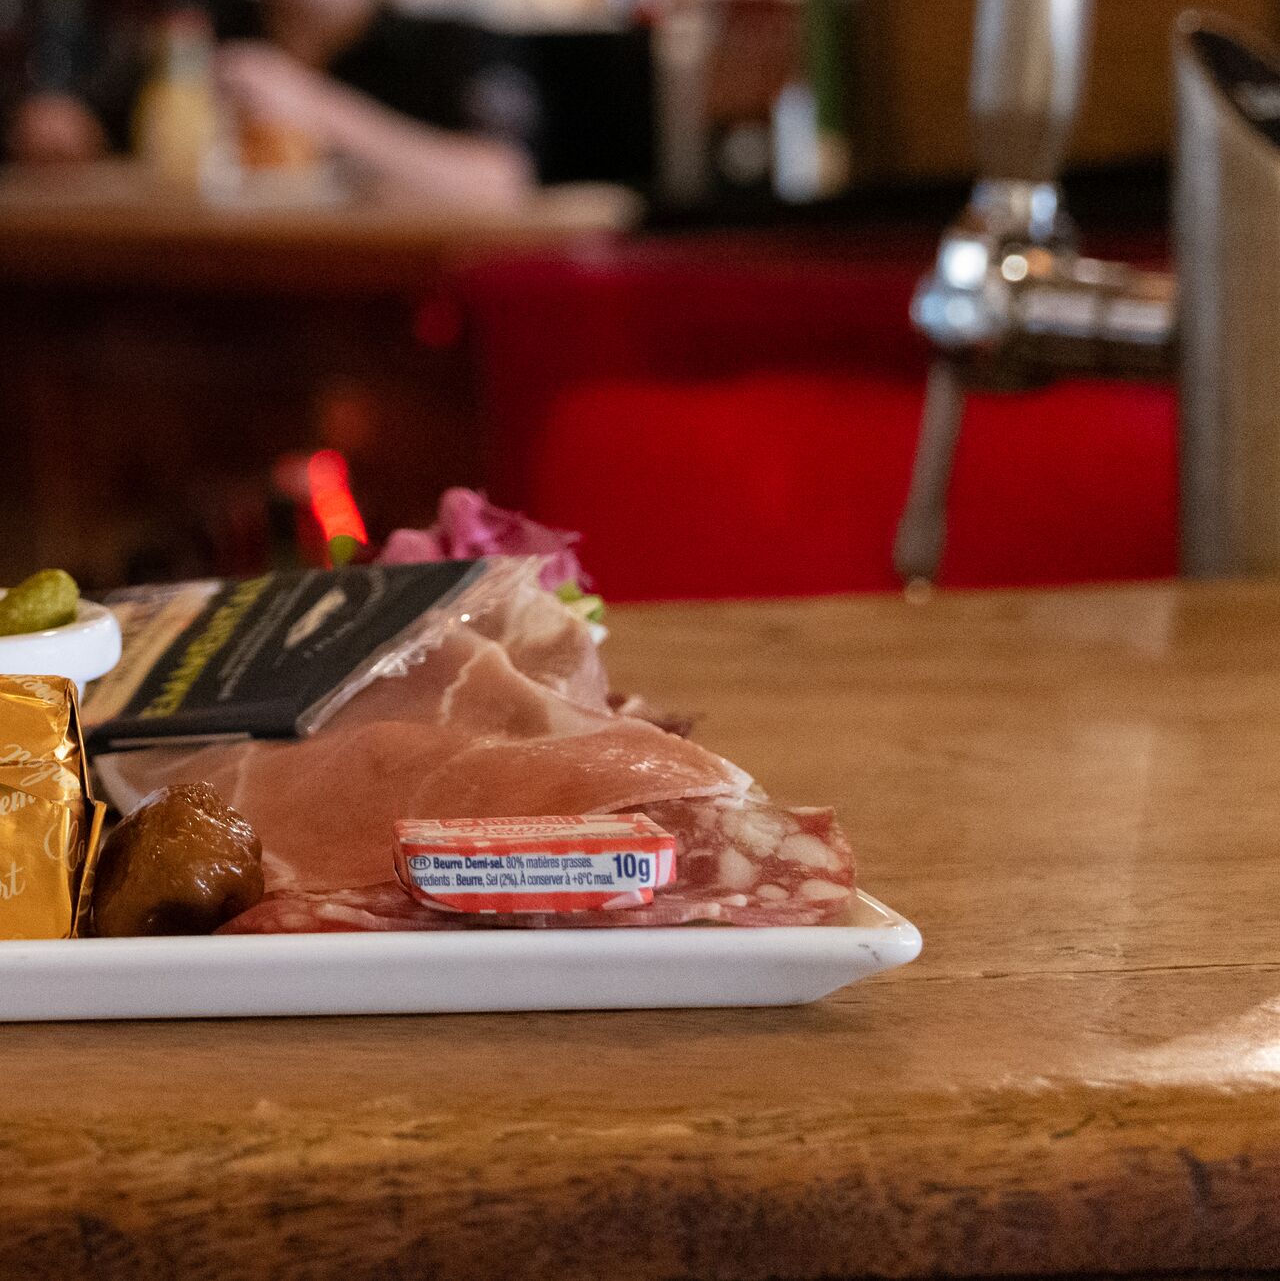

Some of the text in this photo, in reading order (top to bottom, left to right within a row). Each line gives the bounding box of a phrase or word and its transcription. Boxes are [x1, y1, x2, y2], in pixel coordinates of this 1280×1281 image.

[433, 857, 462, 869] Beurre
[506, 856, 524, 869] 80%
[526, 856, 560, 869] matières
[486, 874, 498, 886] Sel
[527, 873, 564, 886] conserver
